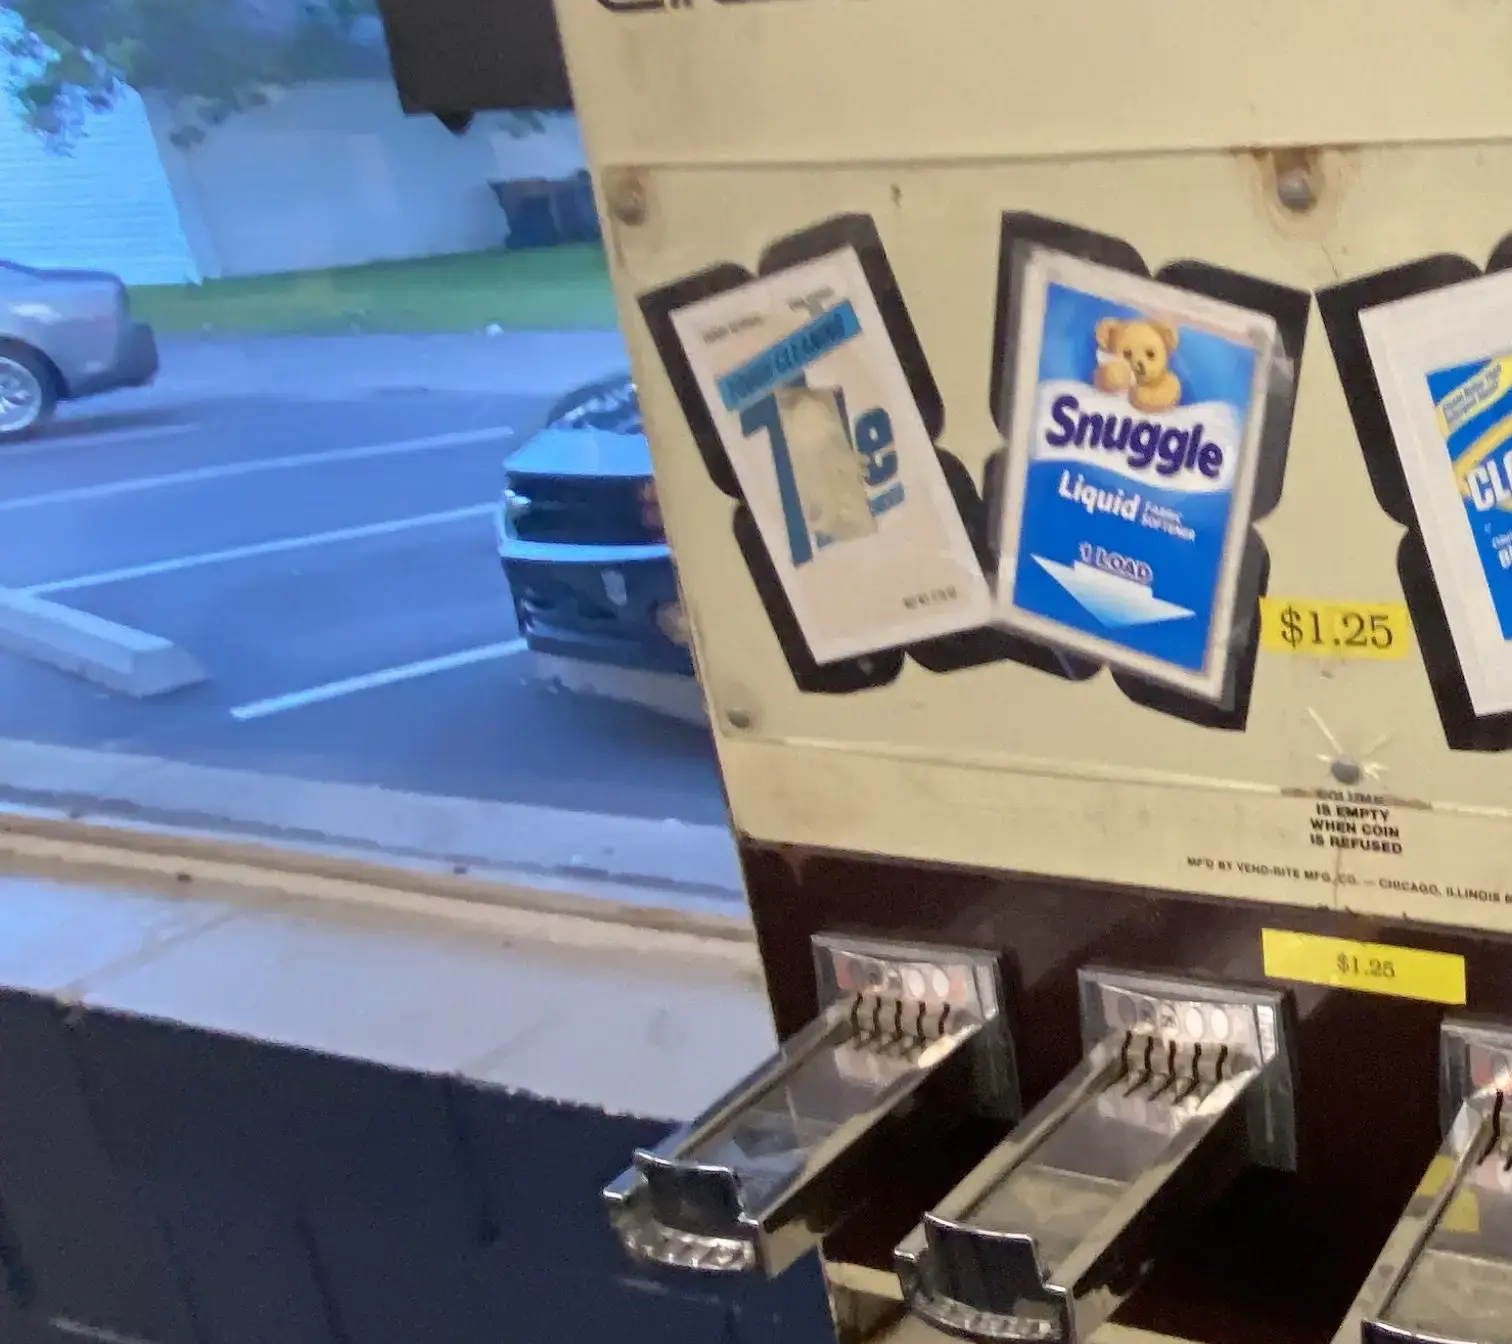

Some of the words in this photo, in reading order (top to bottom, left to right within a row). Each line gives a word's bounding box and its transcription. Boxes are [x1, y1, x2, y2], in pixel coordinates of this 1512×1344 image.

[1045, 395, 1224, 480] Snuggle
[1059, 468, 1141, 523] Liquid
[1095, 545, 1153, 584] LOAD
[1280, 605, 1394, 650] $1.25
[1310, 817, 1357, 834] WHEN
[1361, 823, 1400, 838] COIN
[1316, 802, 1331, 817] IS
[1336, 805, 1390, 822] EMPTY
[1310, 833, 1325, 847] IS
[1330, 835, 1403, 855] REFUSED
[1218, 860, 1234, 871] BY
[1237, 862, 1300, 879] VEND-RITE
[1446, 886, 1500, 904] ILLINOIS
[1336, 951, 1396, 979] $1.25
